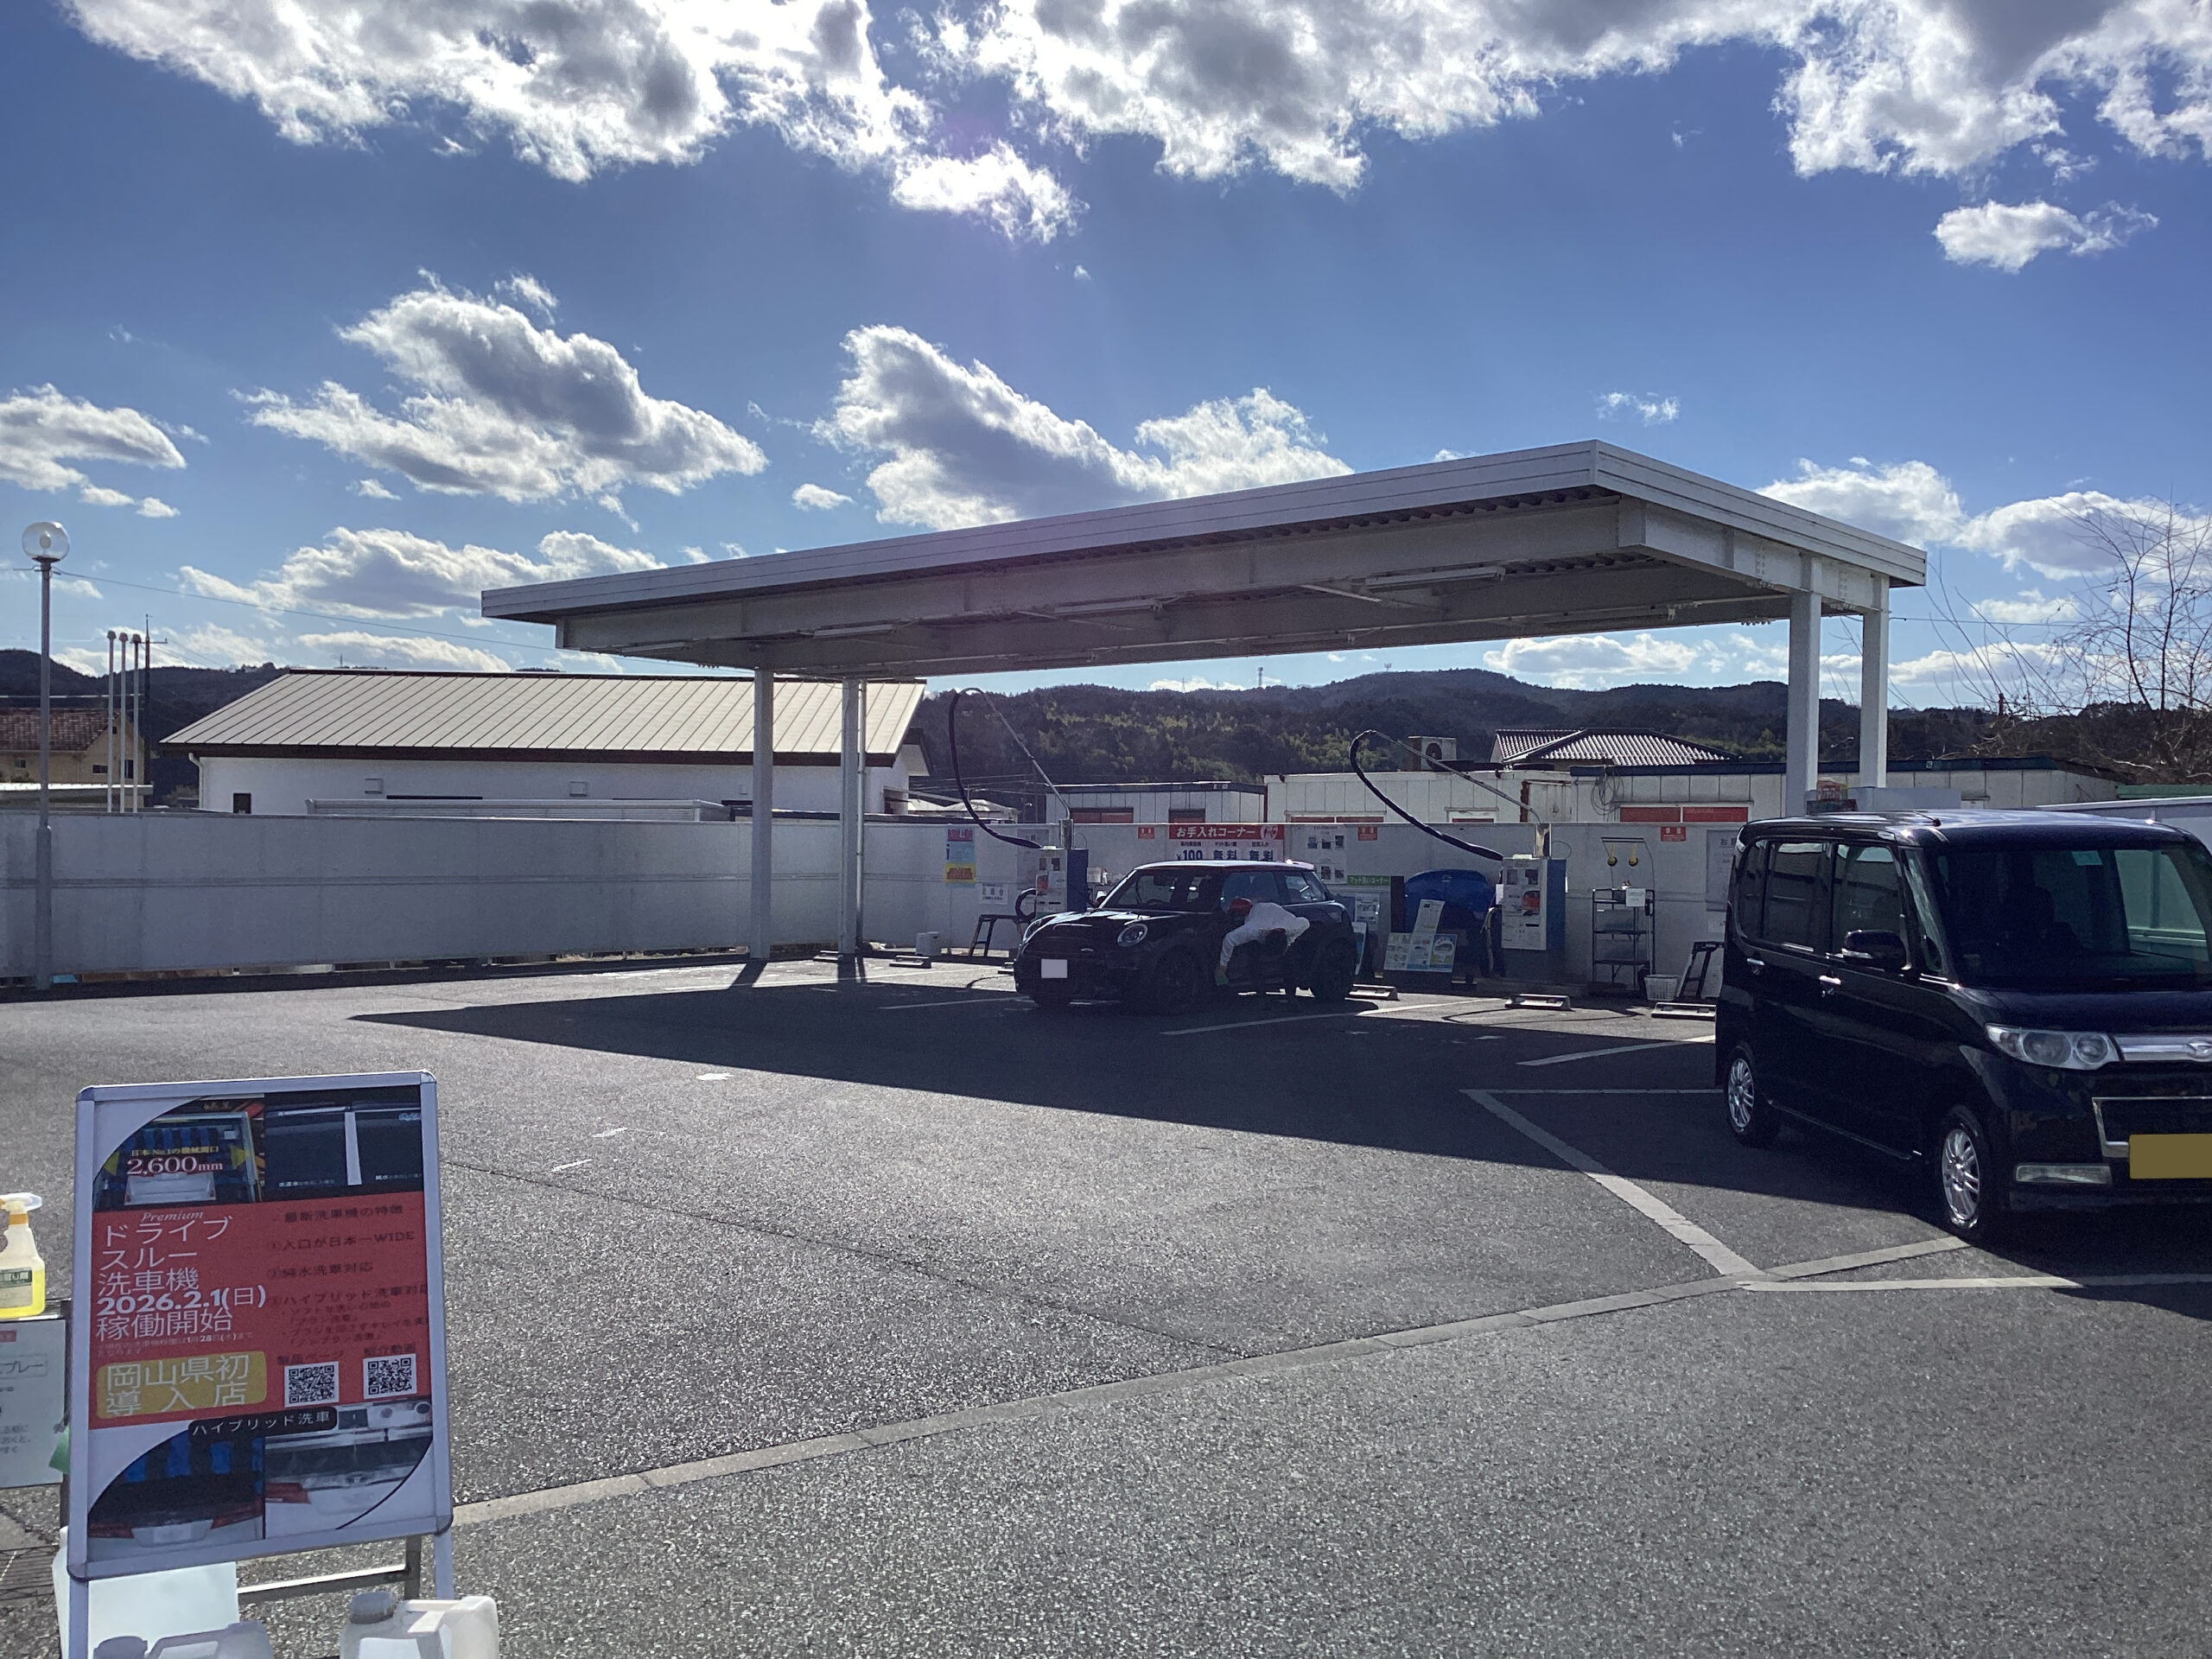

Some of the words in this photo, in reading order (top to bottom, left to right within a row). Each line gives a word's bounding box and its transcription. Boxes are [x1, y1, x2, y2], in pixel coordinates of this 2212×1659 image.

[1176, 826, 1255, 838] お手入れコーナー
[126, 1155, 224, 1175] 2,600mm
[140, 1210, 205, 1223] Premium
[106, 1215, 233, 1248] ドライブ
[99, 1246, 198, 1271] スルー
[97, 1266, 200, 1297] 洗車機
[96, 1284, 266, 1317] 2026.2.1(日)
[95, 1306, 233, 1343] 稼働開始
[0, 1359, 43, 1374] プレー
[106, 1353, 251, 1392] 岡山県初
[105, 1381, 249, 1417] 導入店
[192, 1411, 331, 1436] ハイブリッド洗車
